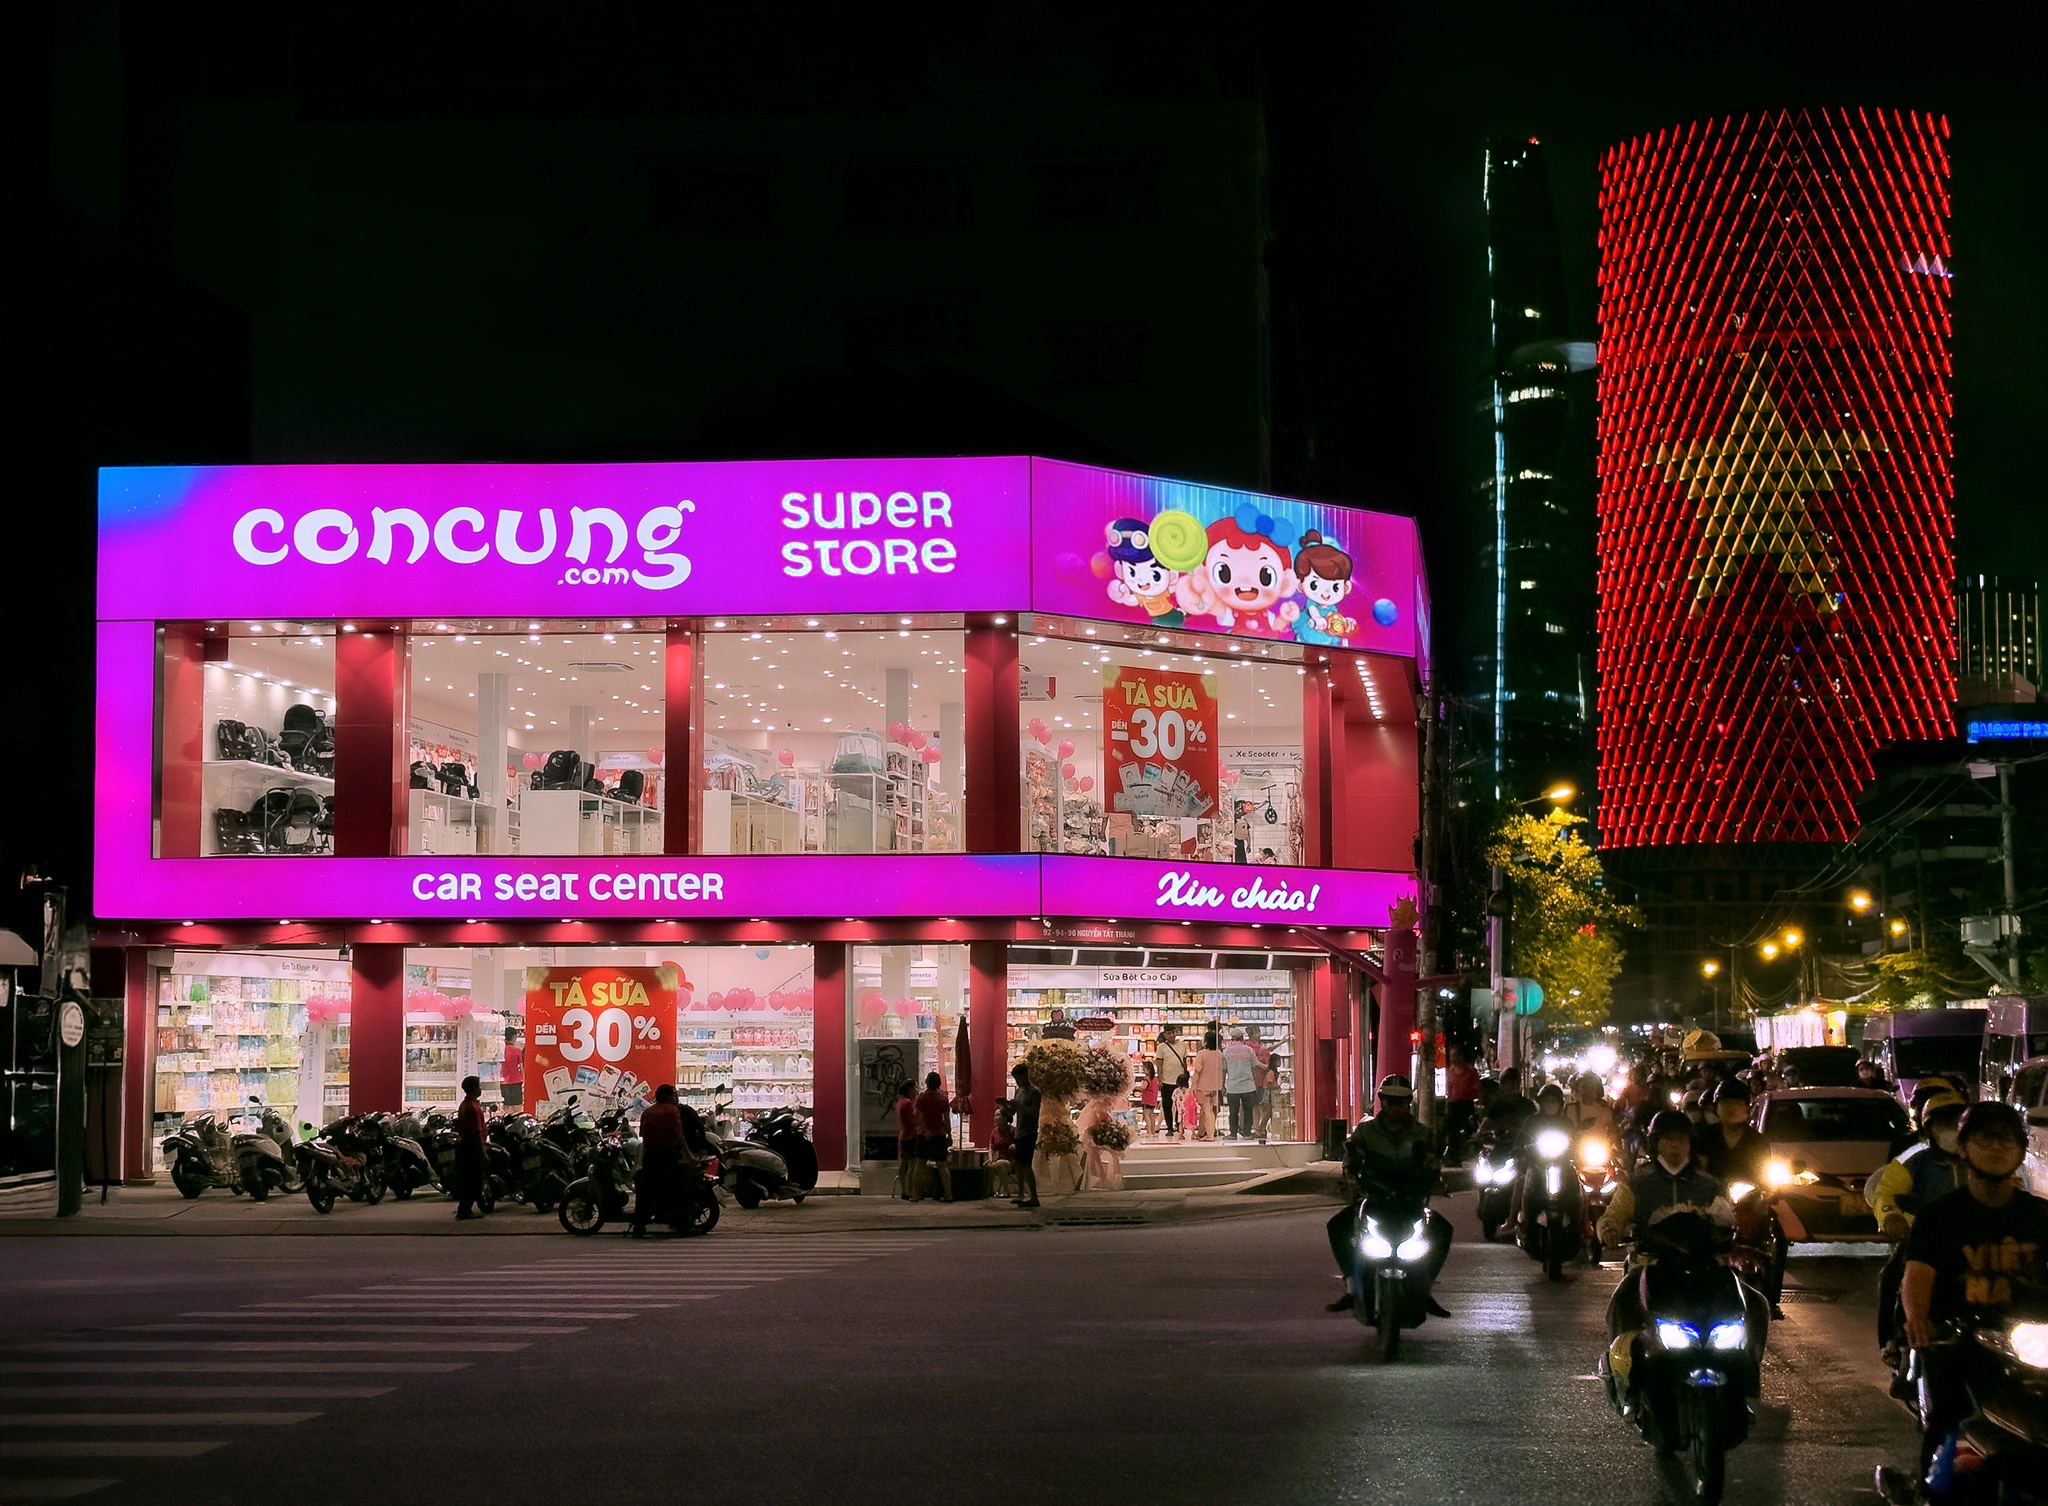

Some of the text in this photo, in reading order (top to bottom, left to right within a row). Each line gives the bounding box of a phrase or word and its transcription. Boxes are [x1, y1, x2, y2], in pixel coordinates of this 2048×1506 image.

[232, 499, 697, 591] concung
[557, 566, 630, 586] .com
[1120, 676, 1199, 711] TÃ SỮA
[1236, 750, 1279, 758] Xe Scooter
[493, 872, 580, 901] seat
[1155, 870, 1321, 912] Xin chào!
[549, 976, 651, 1007] TÃ SỮA
[1140, 972, 1158, 981] Cao
